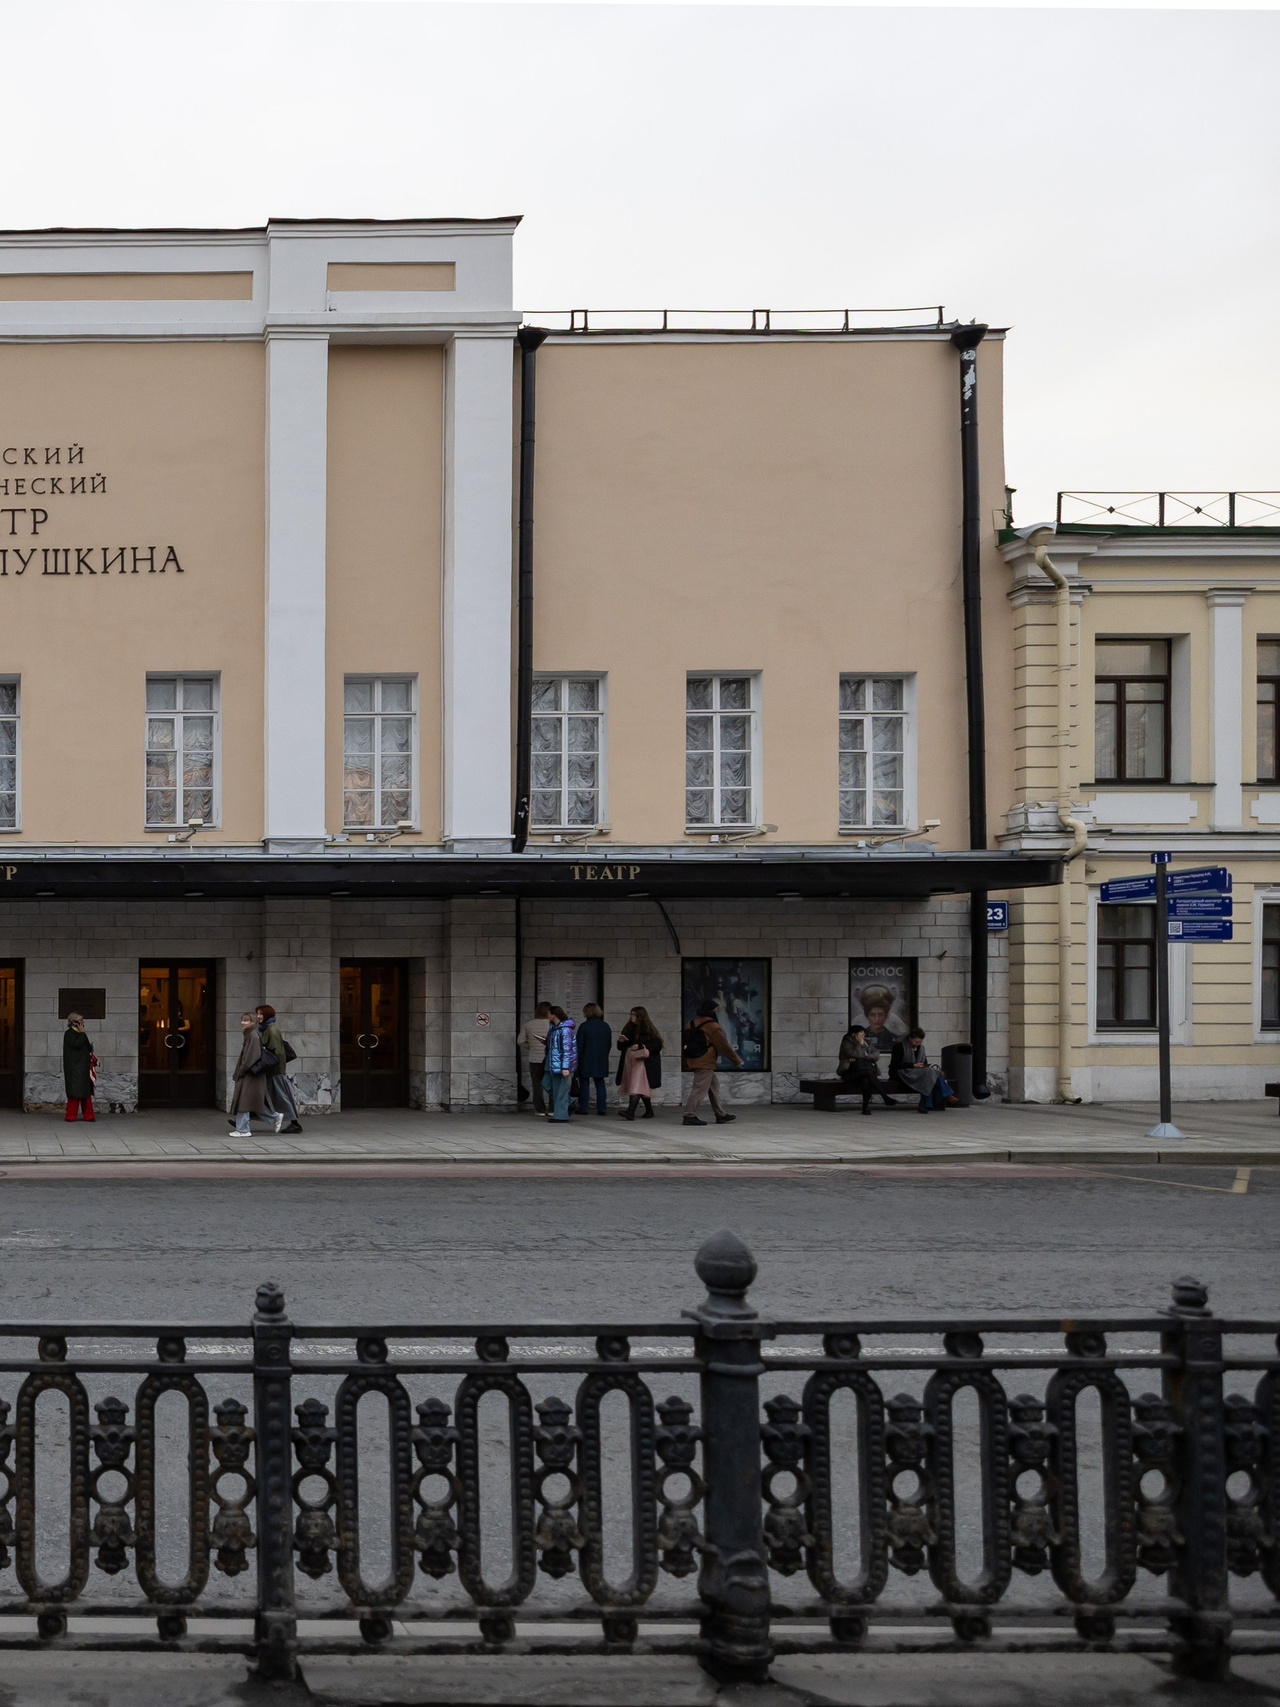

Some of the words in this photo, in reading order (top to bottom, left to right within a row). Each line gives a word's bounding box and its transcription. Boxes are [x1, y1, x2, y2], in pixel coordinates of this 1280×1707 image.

[570, 865, 641, 880] ТЕАТР
[987, 908, 1003, 920] 23
[850, 966, 904, 977] КОСМОС
